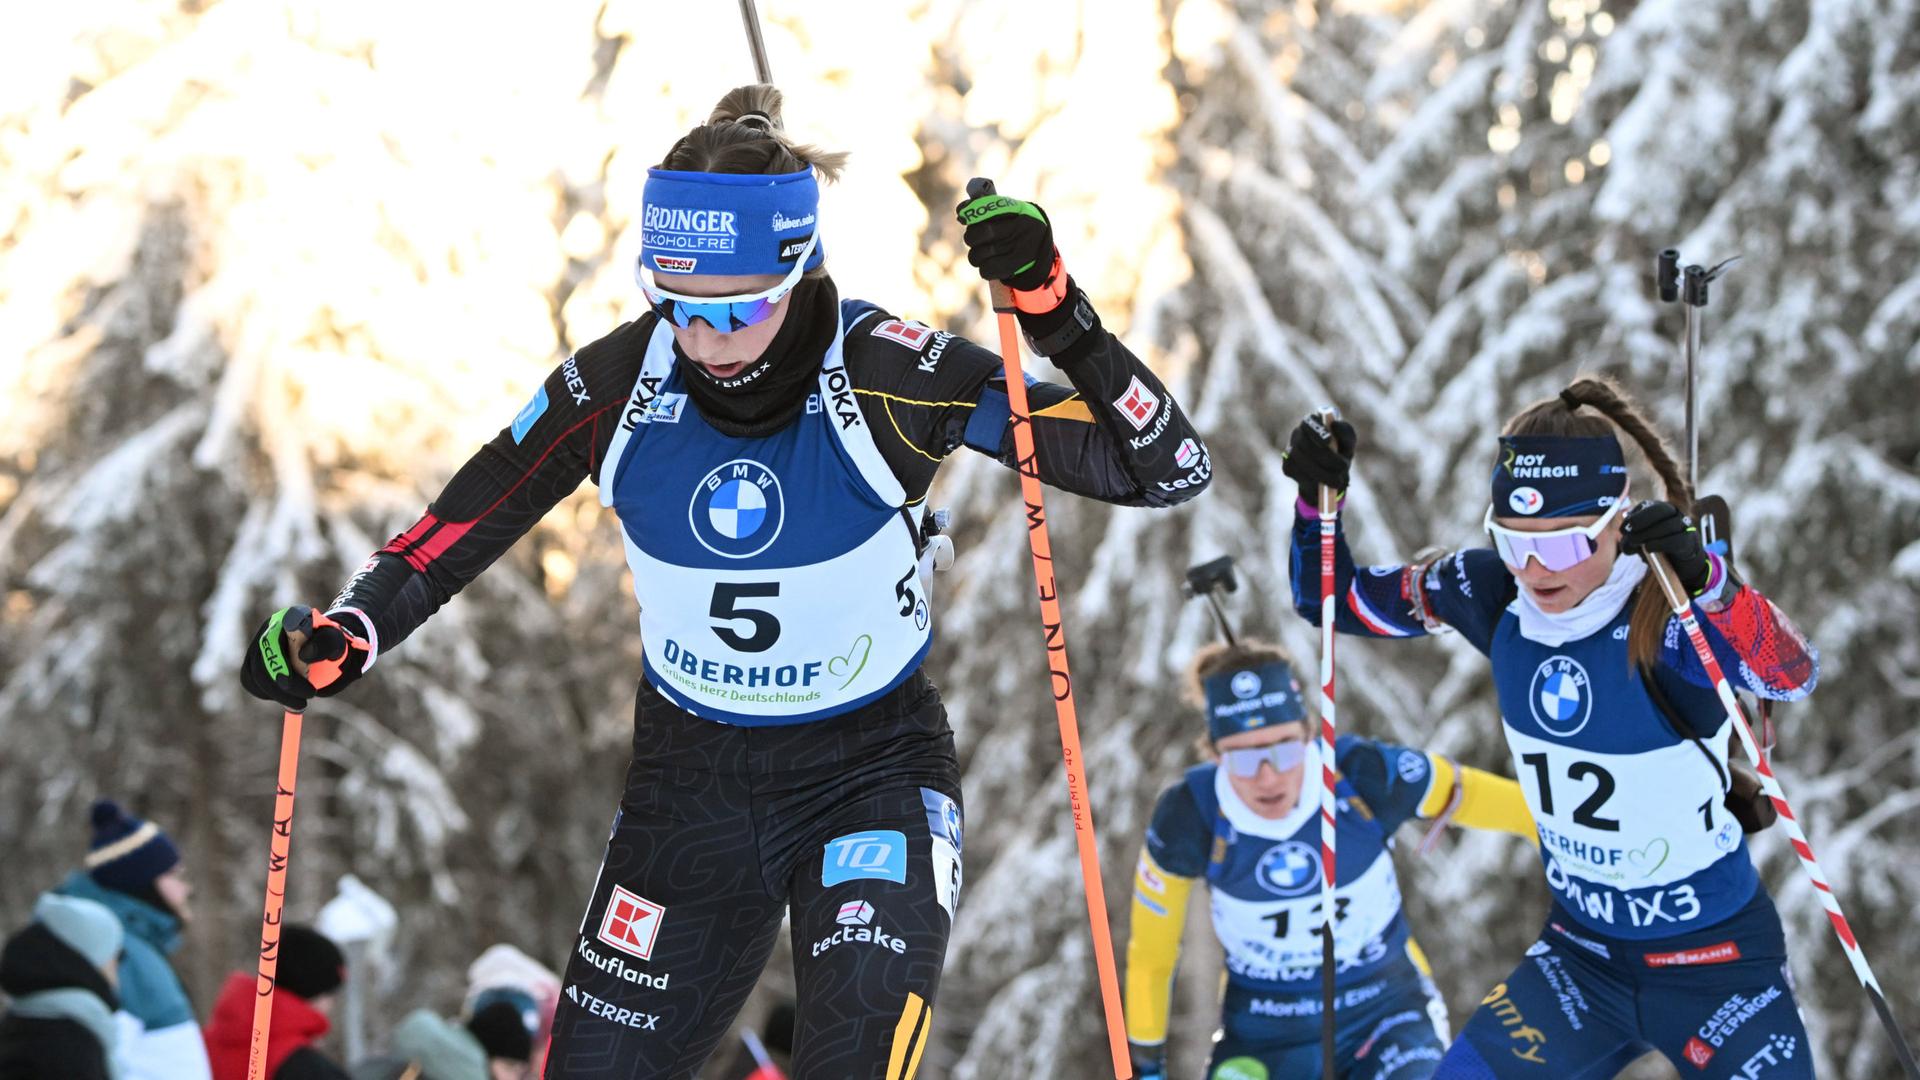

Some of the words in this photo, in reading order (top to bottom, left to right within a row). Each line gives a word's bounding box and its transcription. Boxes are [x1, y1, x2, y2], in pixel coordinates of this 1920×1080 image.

[644, 203, 737, 236] ERDINGER
[822, 366, 859, 430] JOKA
[1129, 392, 1172, 450] Kaufland
[707, 464, 773, 492] BMW
[1513, 465, 1579, 479] ENERGIE
[1515, 454, 1546, 466] ROY
[895, 564, 916, 617] 5
[709, 581, 781, 653] 5
[663, 639, 822, 687] OBERHOF
[1542, 660, 1587, 687] BMW
[700, 684, 728, 698] Herz
[730, 691, 821, 703] Deutschlands
[1064, 748, 1072, 766] 40
[1068, 774, 1083, 830] PREMIO
[1522, 752, 1620, 832] 12
[835, 837, 892, 873] TQ
[812, 926, 907, 957] tectake
[578, 936, 669, 990] Kaufland
[581, 991, 660, 1031] TERREX
[1698, 993, 1748, 1040] CAISSE
